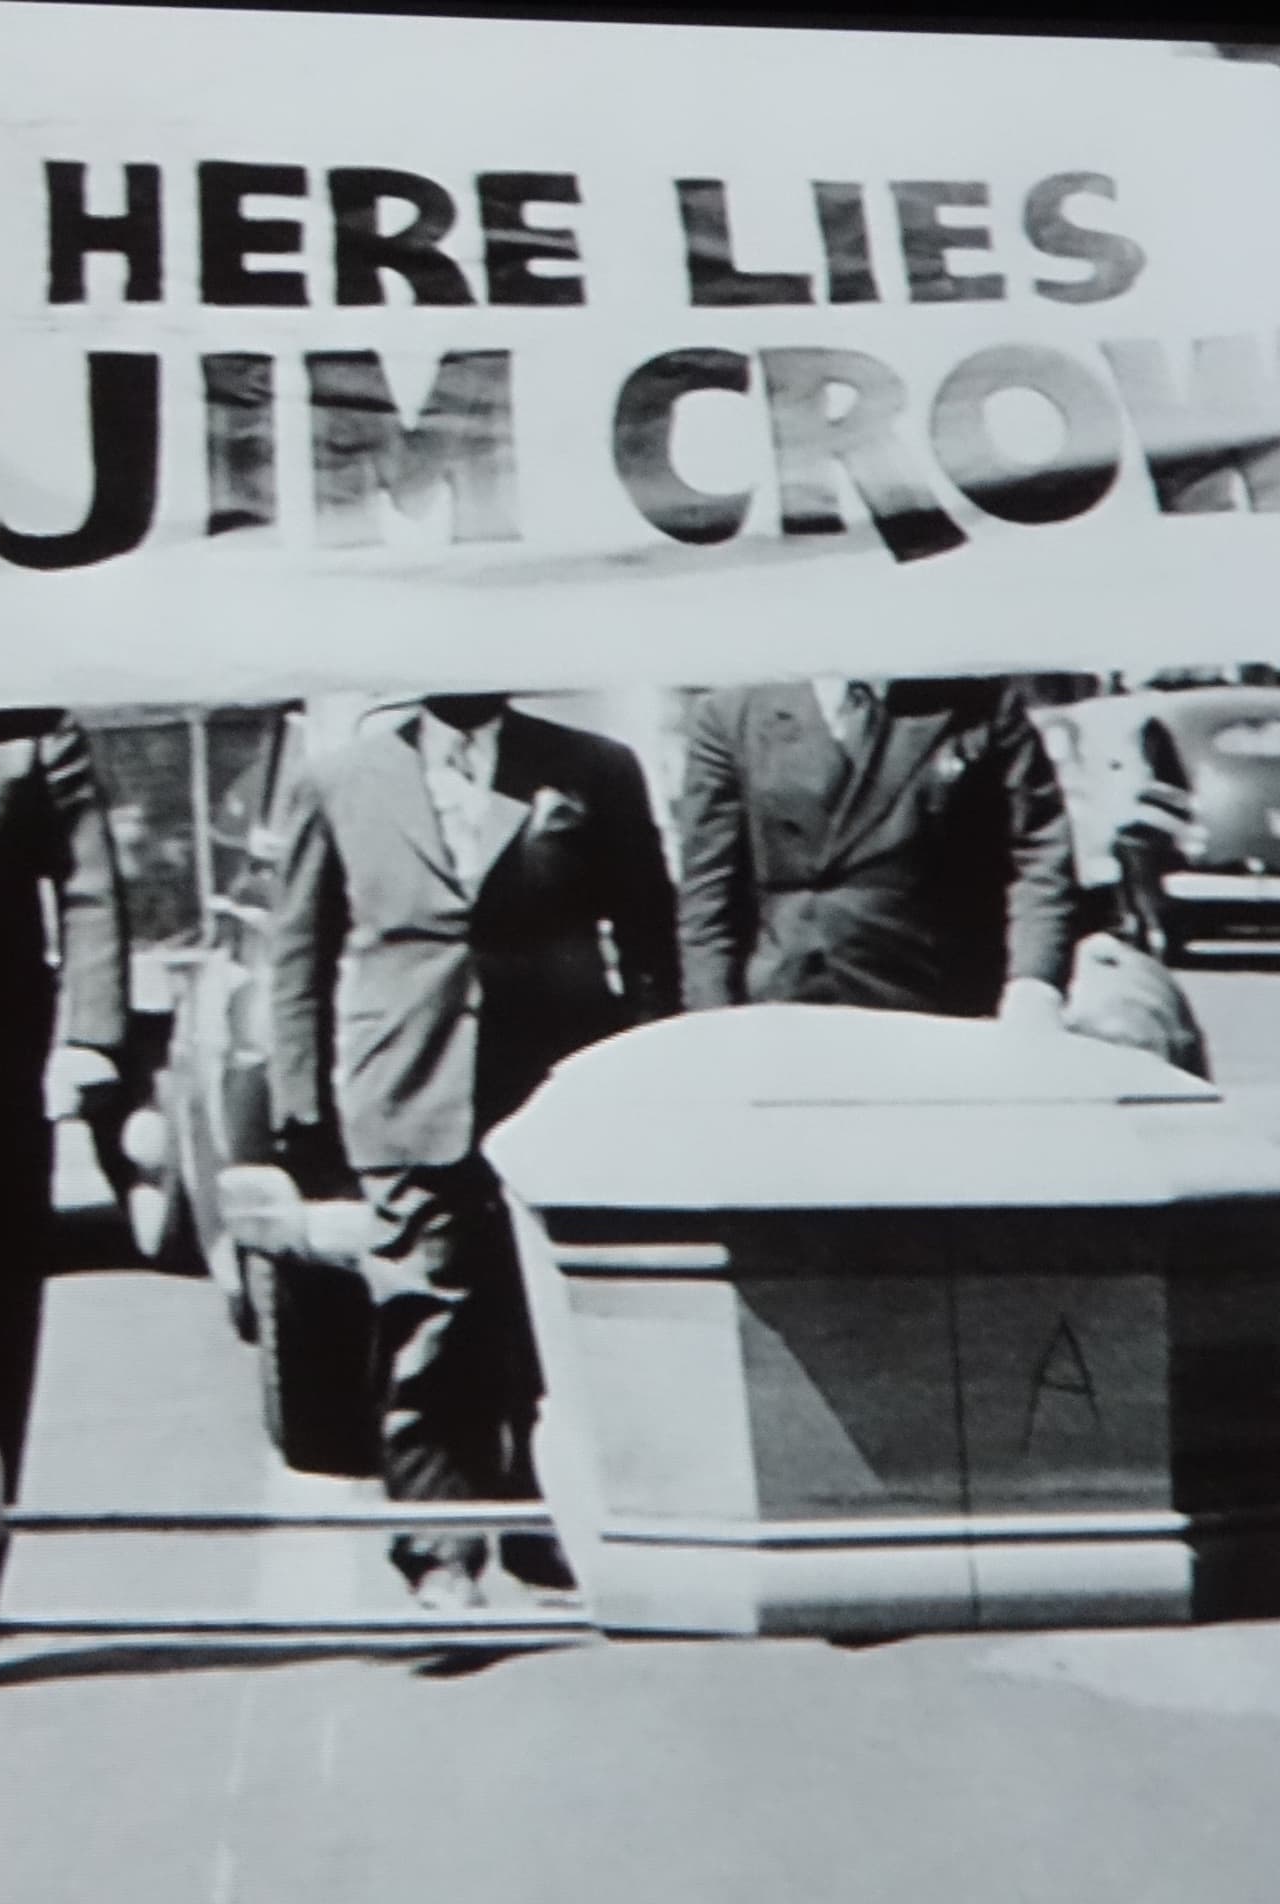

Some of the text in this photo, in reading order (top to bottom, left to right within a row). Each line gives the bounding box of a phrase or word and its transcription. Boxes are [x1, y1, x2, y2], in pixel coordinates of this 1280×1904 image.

[43, 160, 1146, 308] HERE LIES
[1024, 1312, 1103, 1460] A
